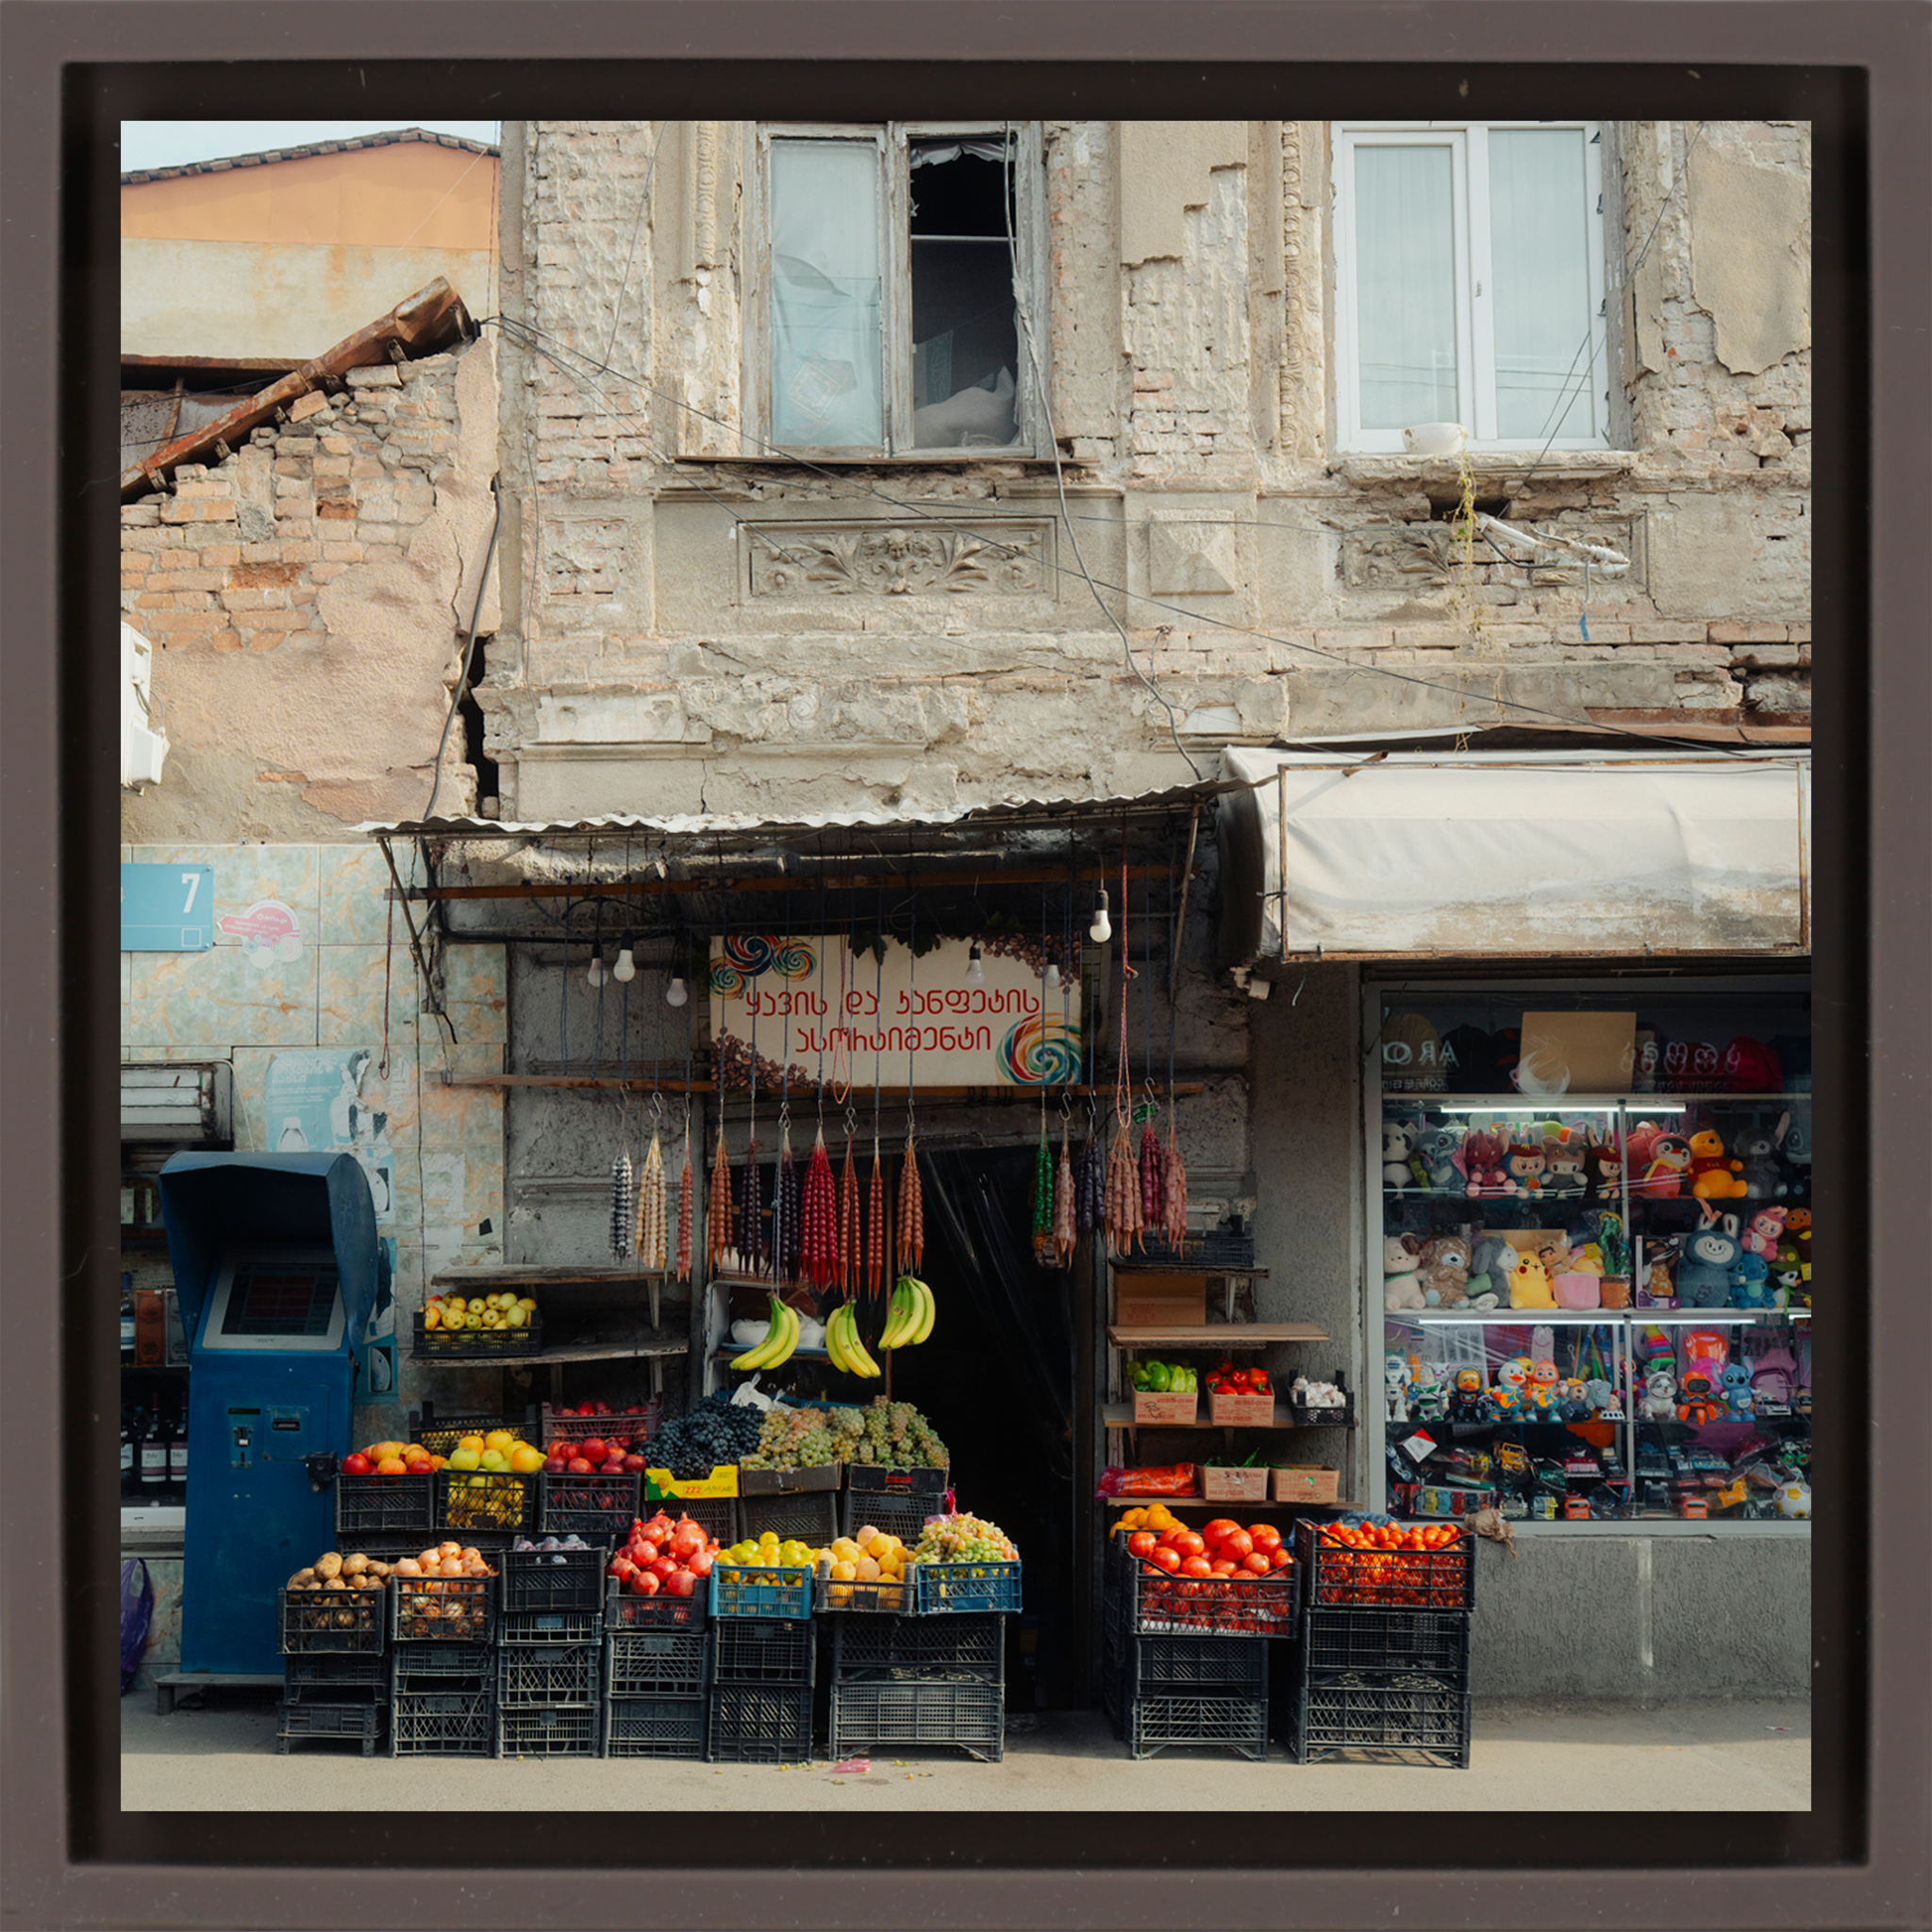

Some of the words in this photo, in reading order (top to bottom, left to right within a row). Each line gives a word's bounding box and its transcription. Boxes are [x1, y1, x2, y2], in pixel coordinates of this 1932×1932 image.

[181, 874, 200, 913] 7
[745, 991, 828, 1017] ყავის
[845, 991, 878, 1016] და
[895, 989, 1040, 1015] კანფეტის
[795, 1025, 991, 1053] ასორტიმენტი
